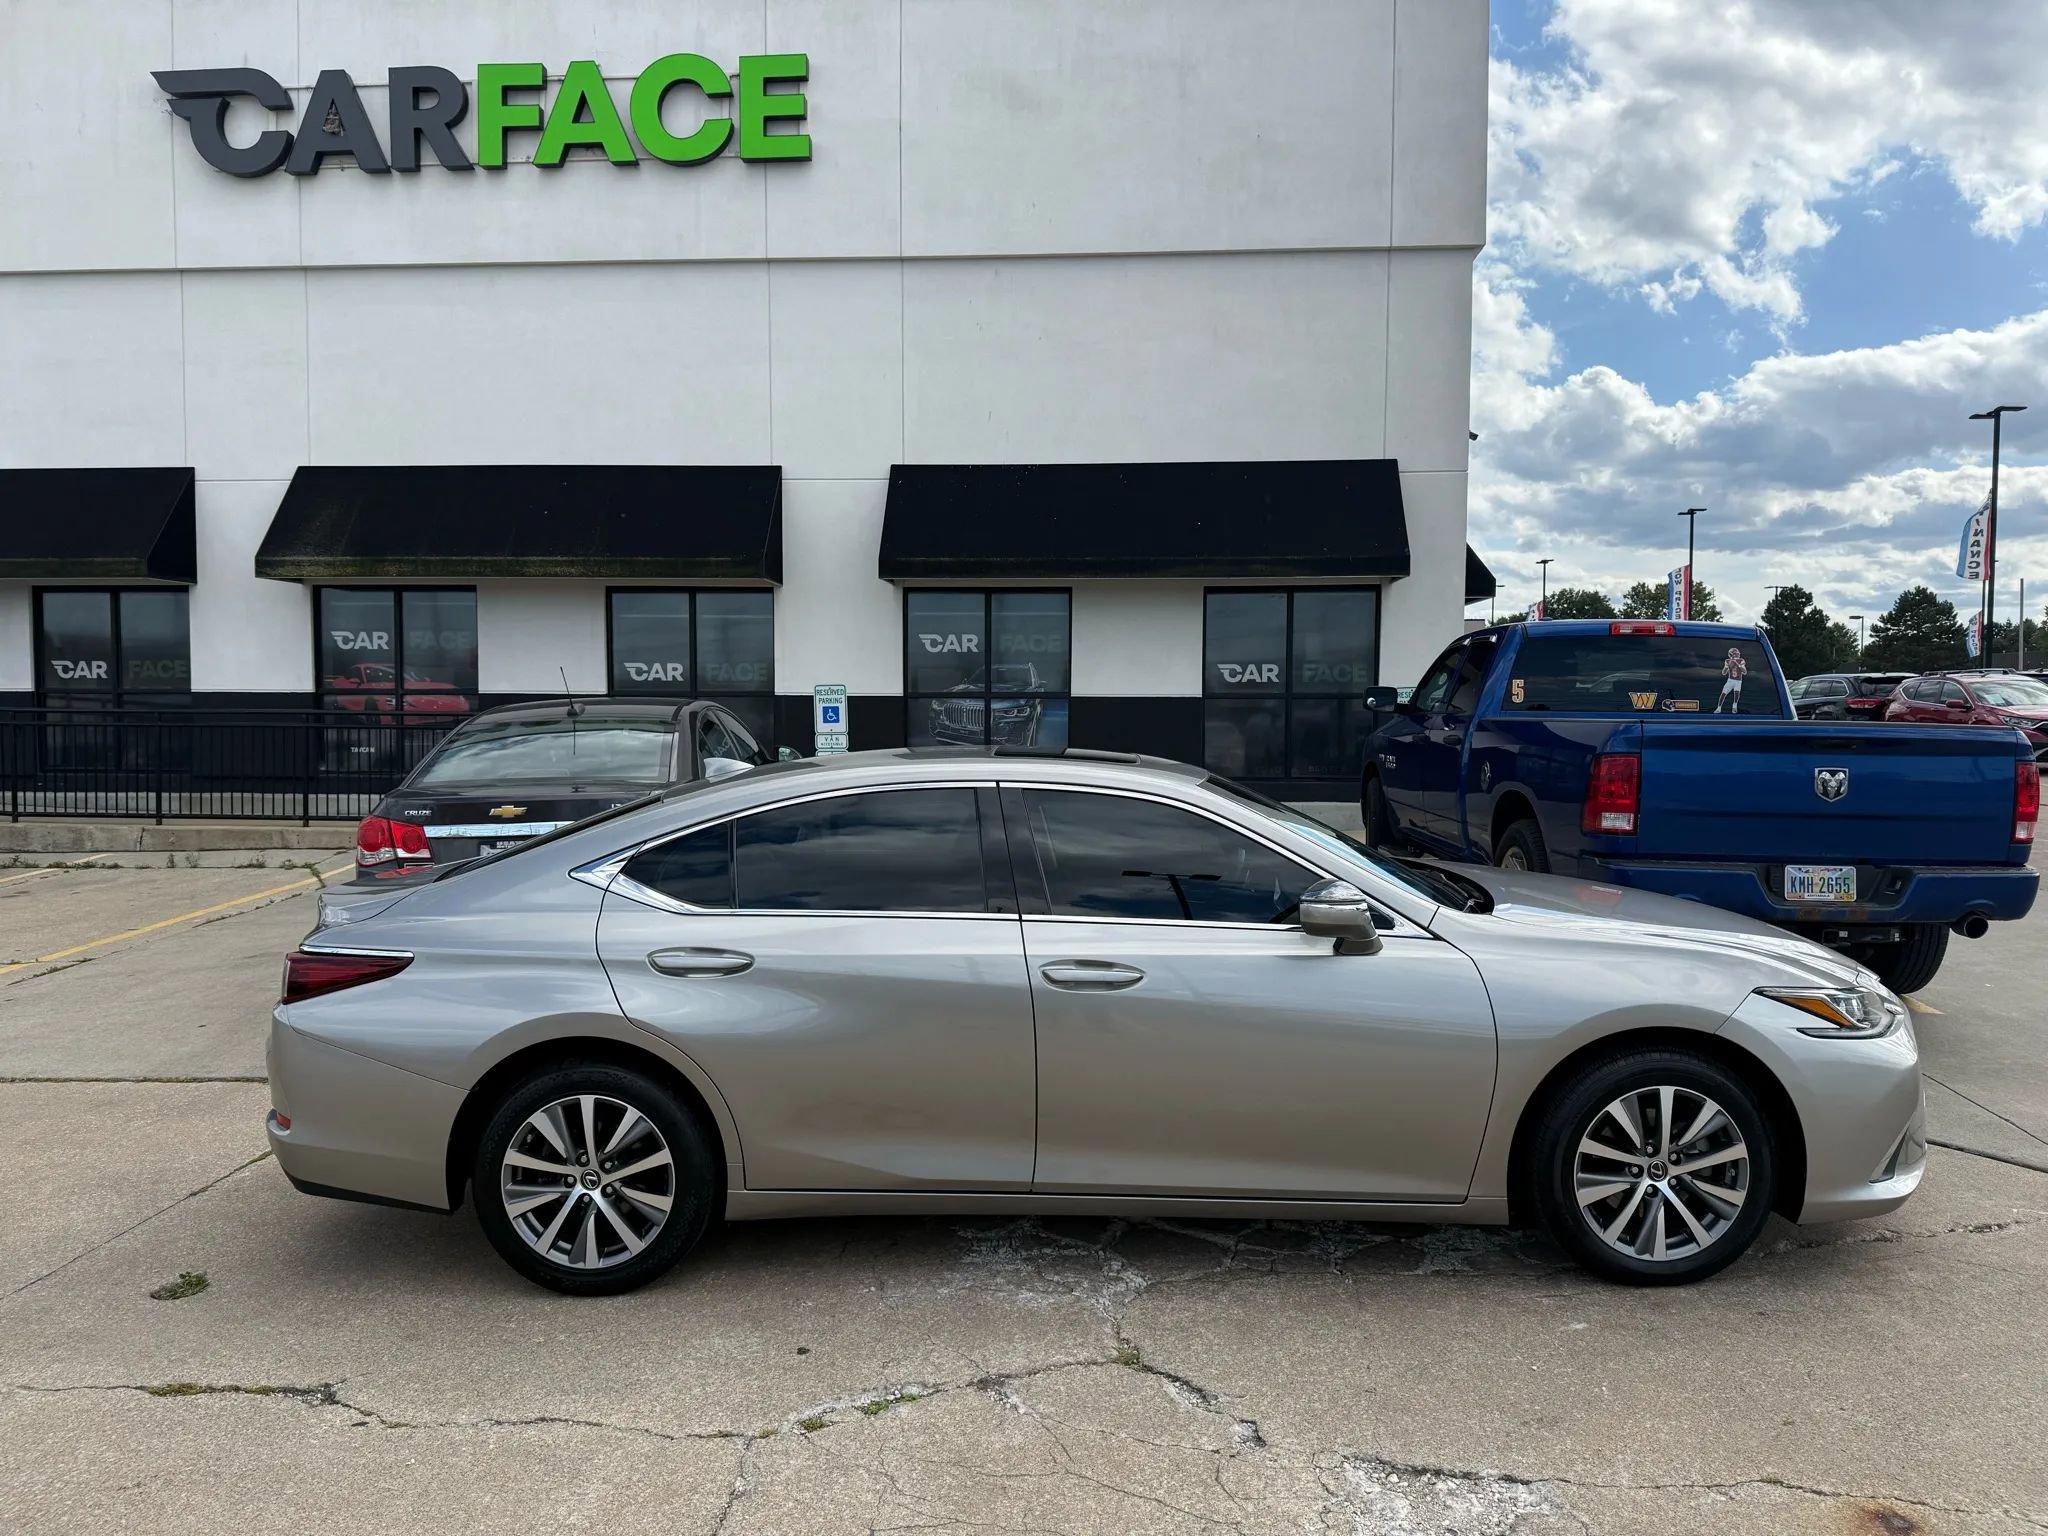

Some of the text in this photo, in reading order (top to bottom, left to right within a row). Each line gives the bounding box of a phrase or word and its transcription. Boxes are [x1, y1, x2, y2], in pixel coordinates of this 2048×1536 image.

[151, 53, 812, 177] CARFACE
[330, 631, 390, 650] CAR
[919, 633, 979, 653] CAR
[51, 660, 187, 679] CAR FACE
[624, 662, 684, 681] CAR
[1217, 663, 1369, 683] CAR FACE
[1511, 679, 1525, 703] 5
[1819, 876, 1850, 894] 2655
